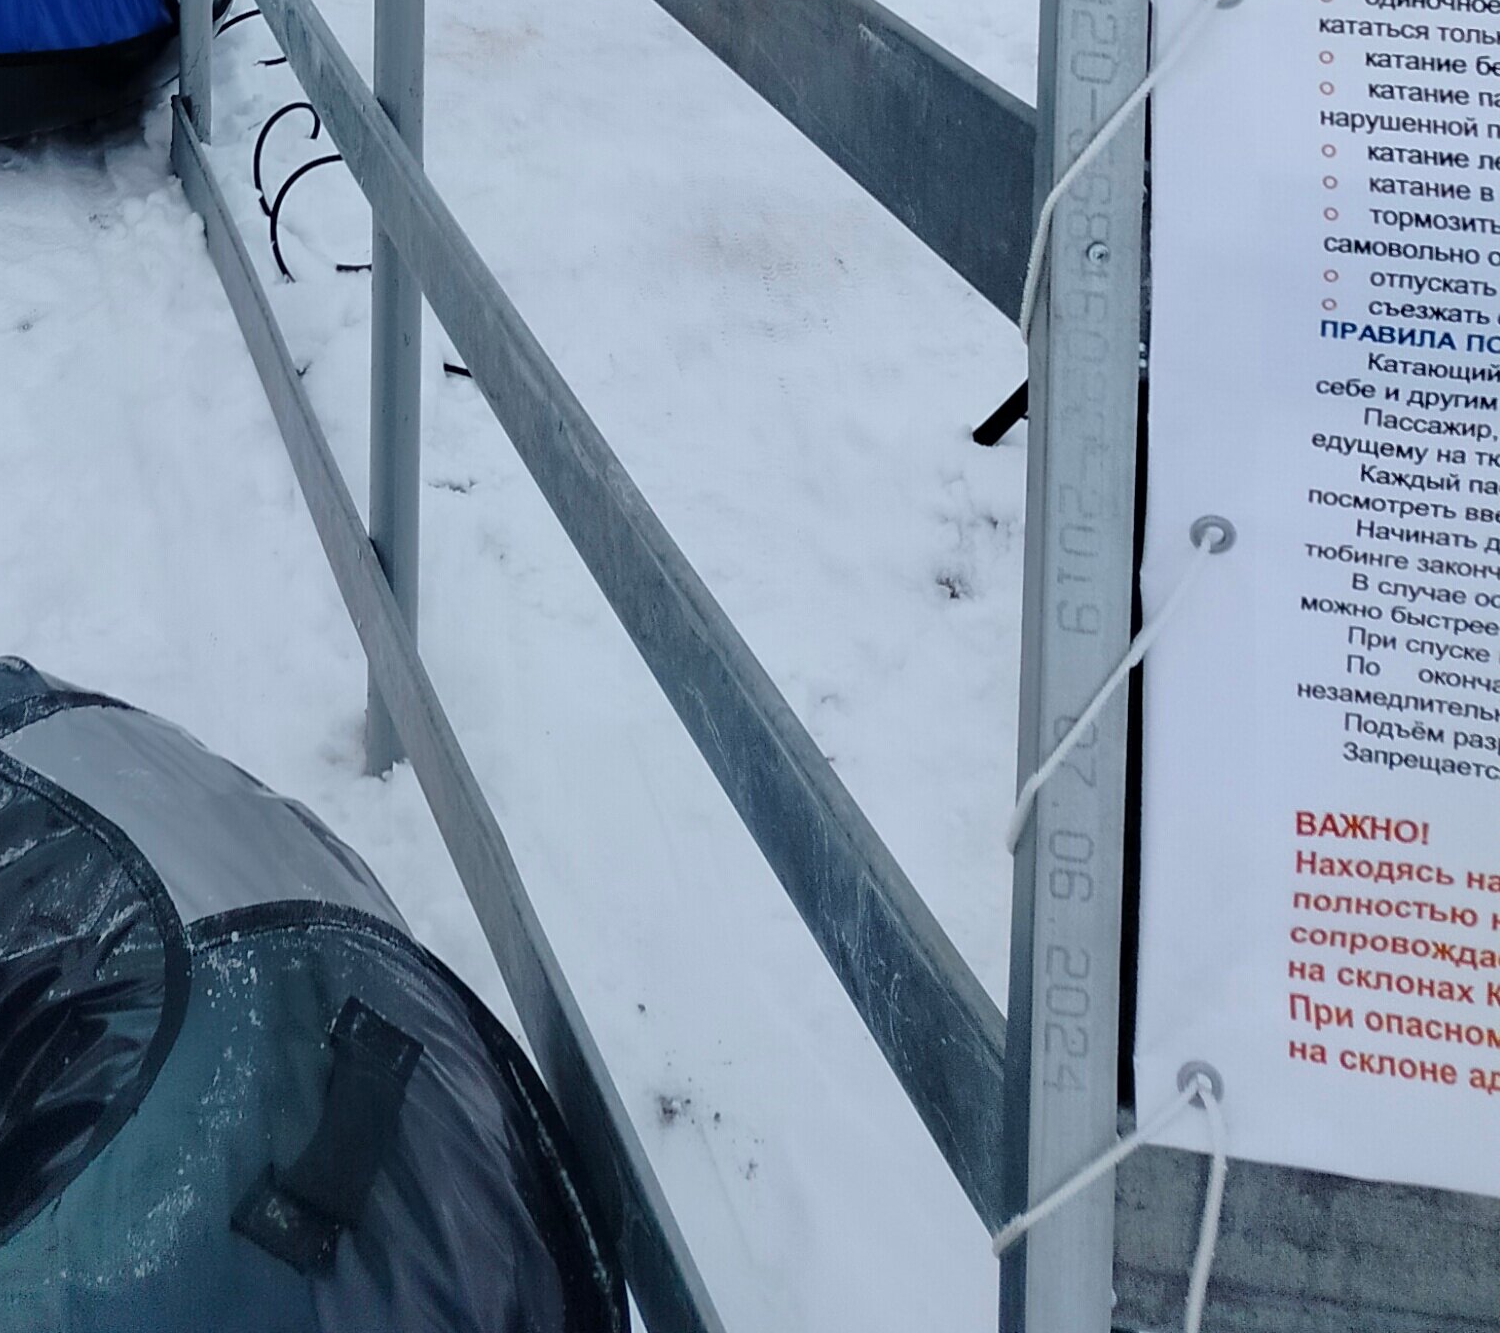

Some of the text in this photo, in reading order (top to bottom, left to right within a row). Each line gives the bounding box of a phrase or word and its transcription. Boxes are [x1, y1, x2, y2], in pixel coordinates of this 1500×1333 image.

[1319, 18, 1500, 45] кататься толь
[1365, 52, 1467, 74] катание
[1368, 83, 1469, 105] катание
[1320, 110, 1479, 138] нарушенной
[1367, 145, 1469, 168] катание
[1369, 177, 1471, 200] катание
[1323, 235, 1480, 265] самовольно
[1370, 271, 1497, 297] отпускать
[1368, 300, 1490, 325] съезжать
[1320, 320, 1456, 350] ПРАВИЛА
[1368, 353, 1500, 384] Катающий
[1316, 378, 1497, 411] себе и другим
[1364, 407, 1498, 442] Пассажир,
[1312, 432, 1428, 465] едущему
[1436, 447, 1466, 464] на
[1360, 464, 1460, 492] Каждый
[1308, 488, 1456, 519] посмотреть
[1356, 519, 1477, 549] Начинать
[1305, 543, 1409, 570] тюбинге
[1352, 573, 1369, 591] В
[1378, 580, 1466, 604] случае
[1301, 596, 1499, 637] можно быстрее
[1348, 626, 1490, 663] При спуске
[1347, 655, 1381, 676] По
[1344, 713, 1444, 744] Подъём
[1296, 811, 1430, 845] ВАЖНО!
[1296, 850, 1455, 885] Находясь
[1292, 891, 1478, 927] полностью
[1290, 925, 1500, 971] сопровожда
[1288, 961, 1325, 982] на
[1337, 965, 1474, 1004] склонах
[1290, 993, 1354, 1031] При
[1289, 1040, 1327, 1064] на
[1339, 1049, 1457, 1085] склоне
